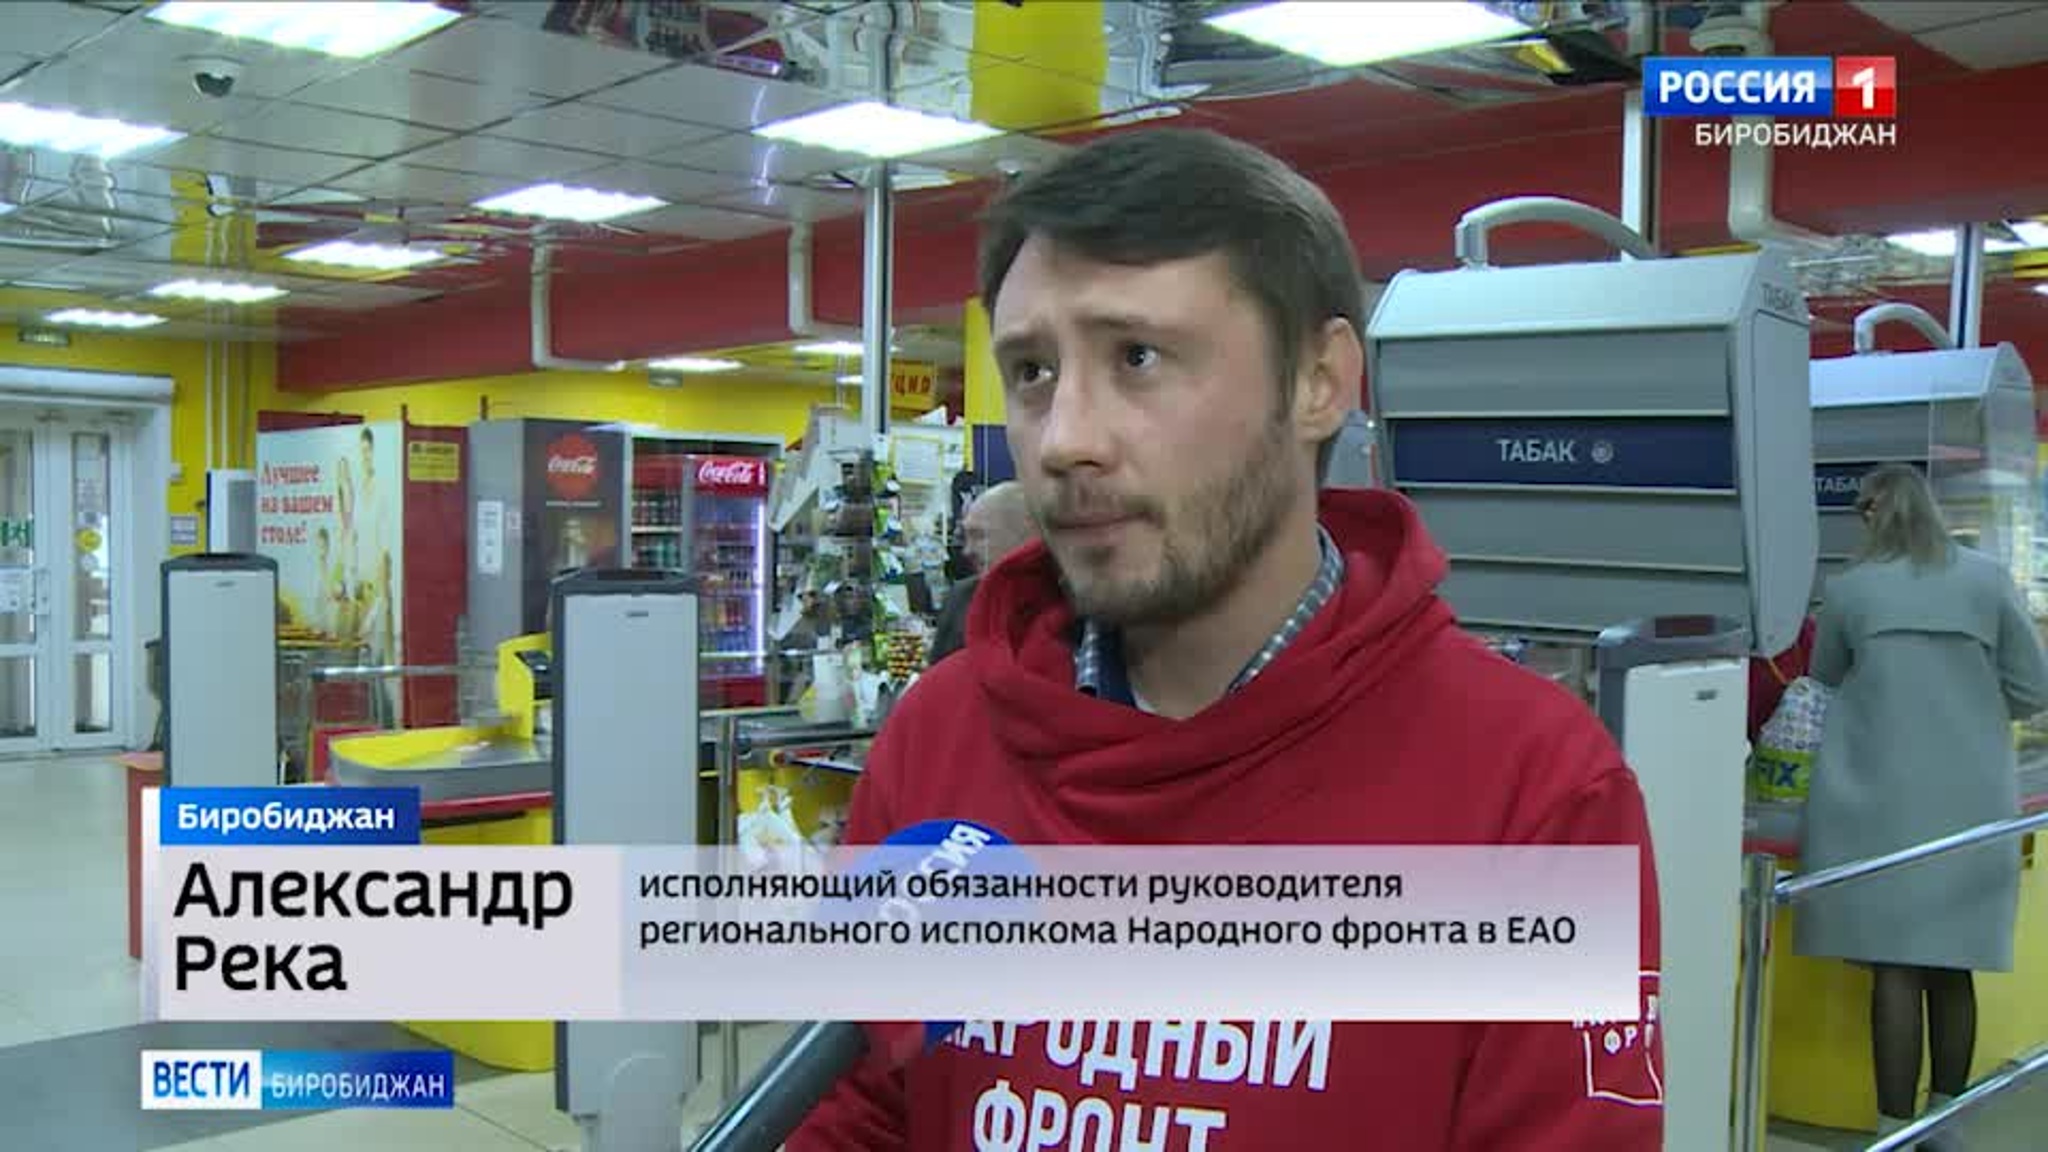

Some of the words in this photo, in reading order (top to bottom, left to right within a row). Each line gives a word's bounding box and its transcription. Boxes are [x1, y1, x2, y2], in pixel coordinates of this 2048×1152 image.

[1496, 438, 1576, 462] ТАБАК
[262, 495, 278, 514] на
[972, 1078, 1228, 1152] ФРОНТ
